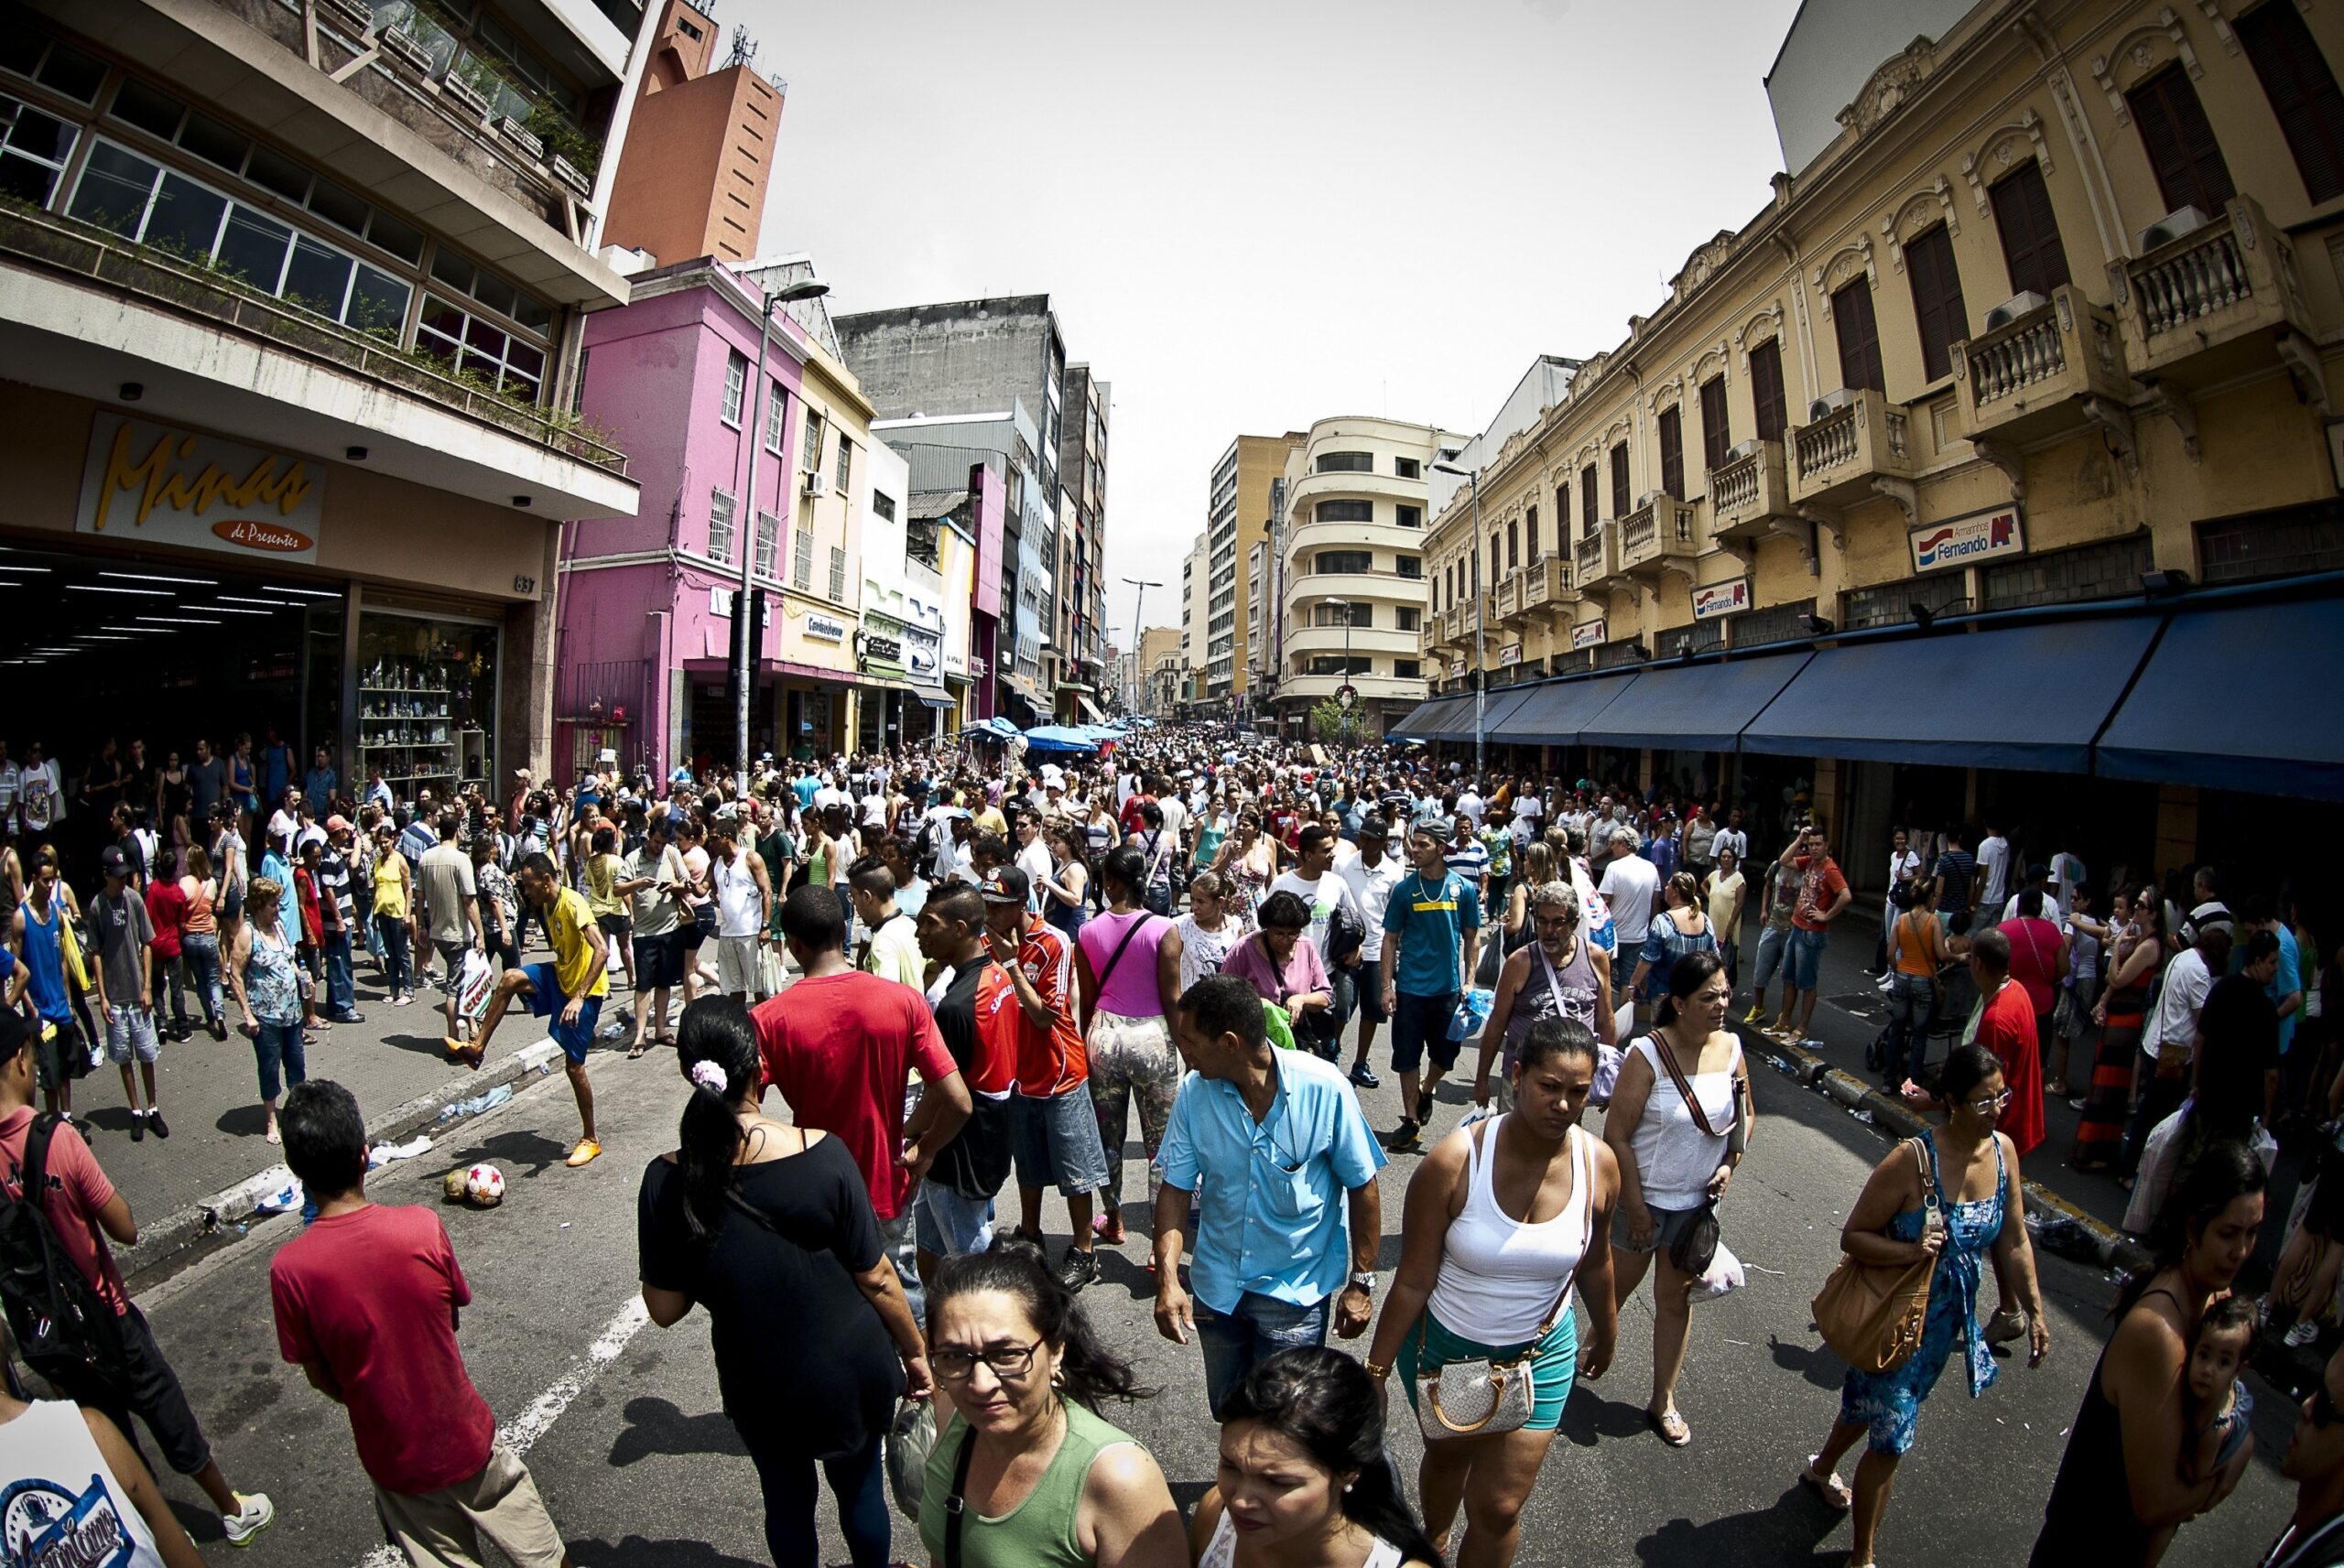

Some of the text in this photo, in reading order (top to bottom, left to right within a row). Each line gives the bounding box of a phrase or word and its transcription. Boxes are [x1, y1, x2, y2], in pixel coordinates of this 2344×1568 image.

[95, 420, 312, 530] Minas
[231, 524, 298, 548] de Presentes
[1954, 521, 1989, 538] Armarinhos
[1937, 535, 1988, 560] Fernando
